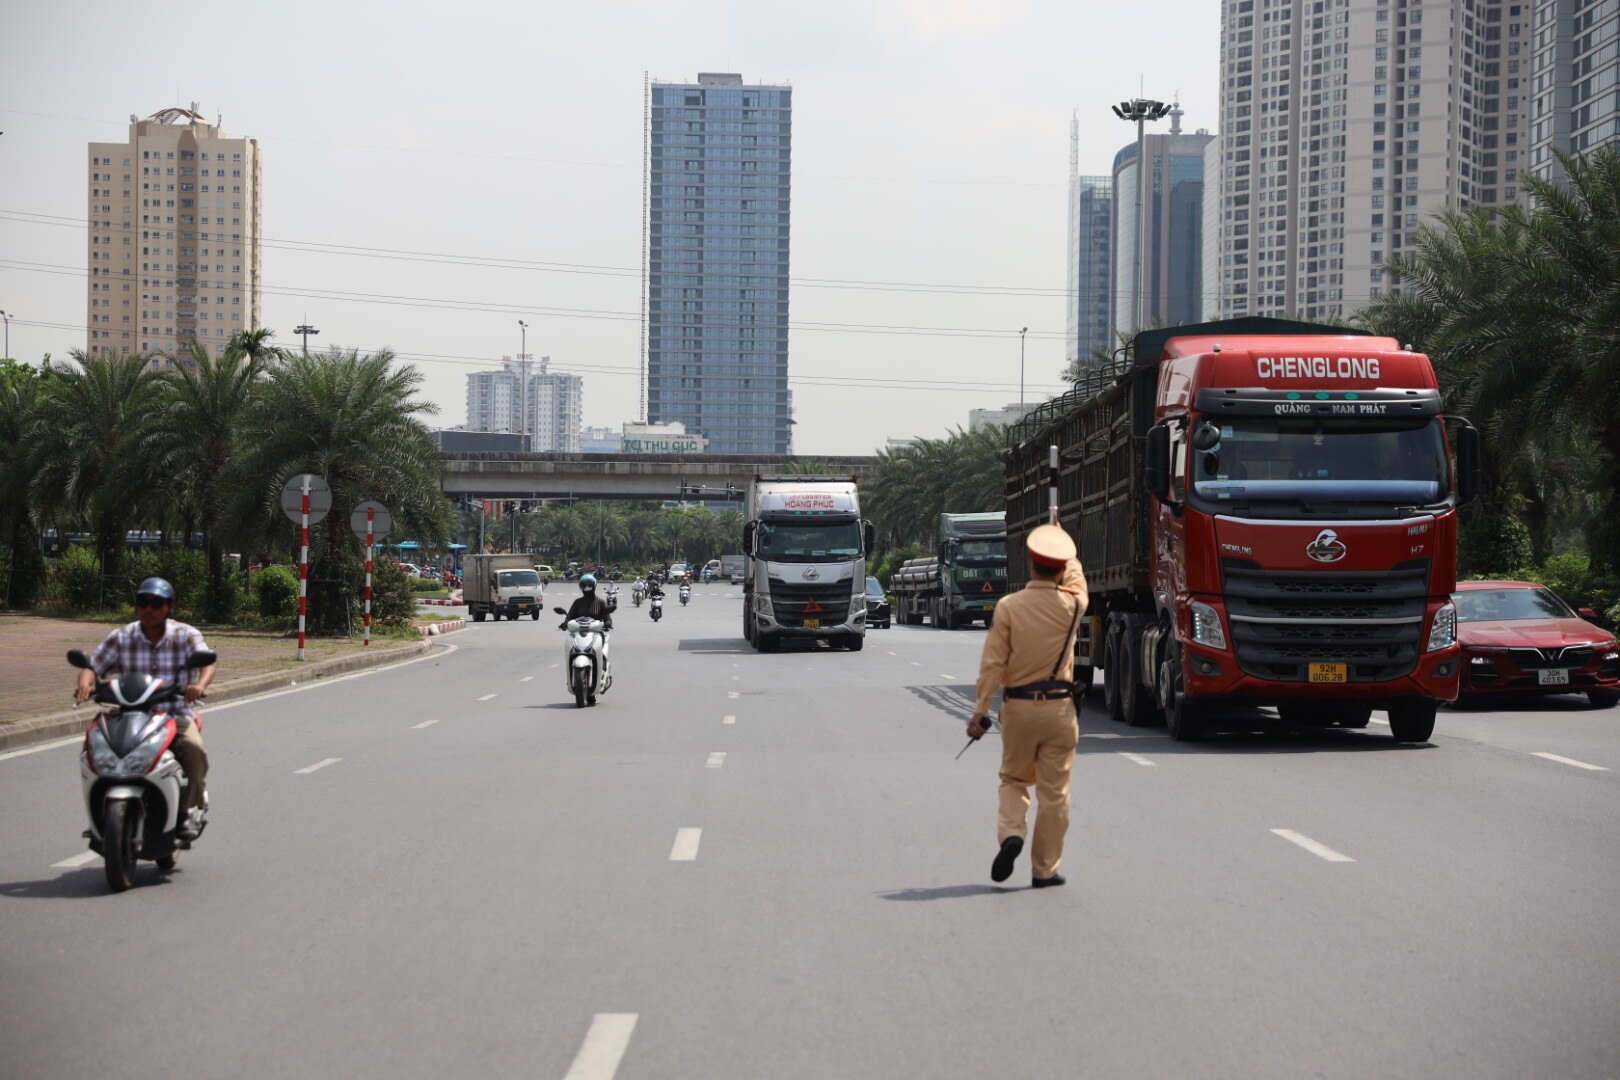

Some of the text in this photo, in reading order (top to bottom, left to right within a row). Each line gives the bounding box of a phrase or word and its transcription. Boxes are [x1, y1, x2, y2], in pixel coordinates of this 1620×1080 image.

[1257, 357, 1380, 379] CHENGLONG
[1332, 405, 1356, 414] NAM
[1359, 403, 1387, 414] PHÁT
[1319, 663, 1337, 672] 92H
